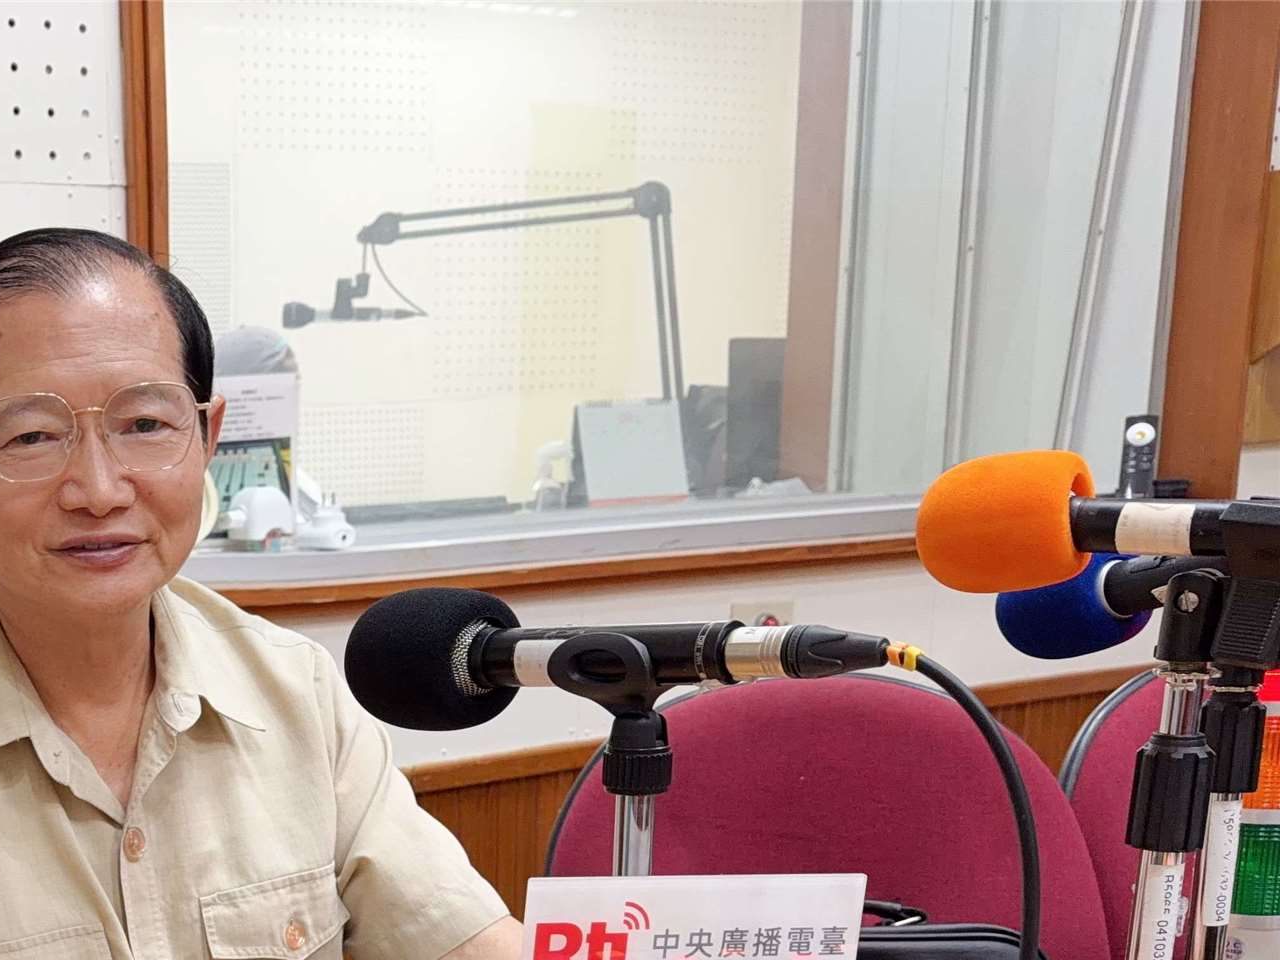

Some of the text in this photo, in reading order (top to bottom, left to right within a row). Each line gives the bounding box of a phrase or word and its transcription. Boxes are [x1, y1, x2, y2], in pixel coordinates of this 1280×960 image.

[652, 925, 848, 959] 中央廣播電臺
